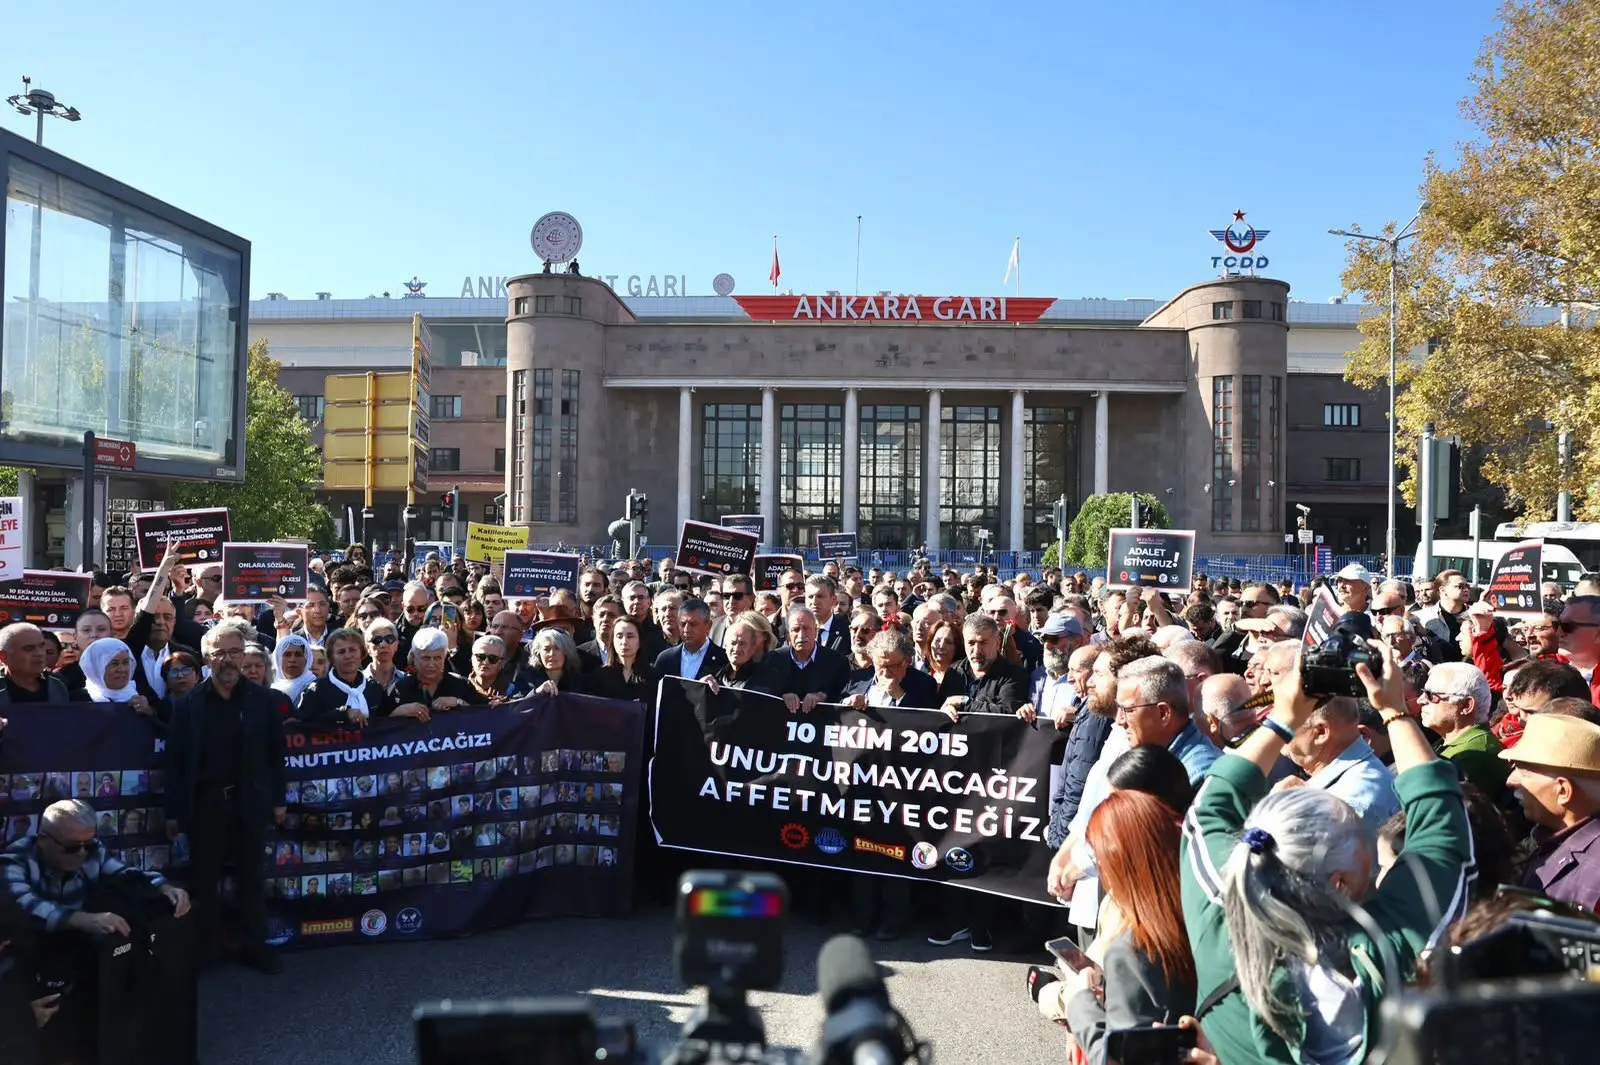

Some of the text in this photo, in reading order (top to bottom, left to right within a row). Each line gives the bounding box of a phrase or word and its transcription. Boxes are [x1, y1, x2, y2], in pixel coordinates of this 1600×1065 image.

[1210, 256, 1270, 269] TCDD
[460, 276, 508, 299] ANK
[627, 274, 686, 298] GARI
[793, 296, 1007, 321] ANKARA GARI
[187, 526, 222, 534] DEMOKRASİ
[687, 538, 743, 553] UNUTTURMAYACAĞIZ
[1129, 547, 1165, 556] ADALET
[1124, 552, 1179, 568] İSTİYORUZ!
[31, 595, 50, 603] KARŞI
[786, 718, 969, 758] 10 EKİM 2015
[710, 741, 1038, 804] UNUTTURMAYACAĞIZ
[855, 836, 905, 858] tmmob
